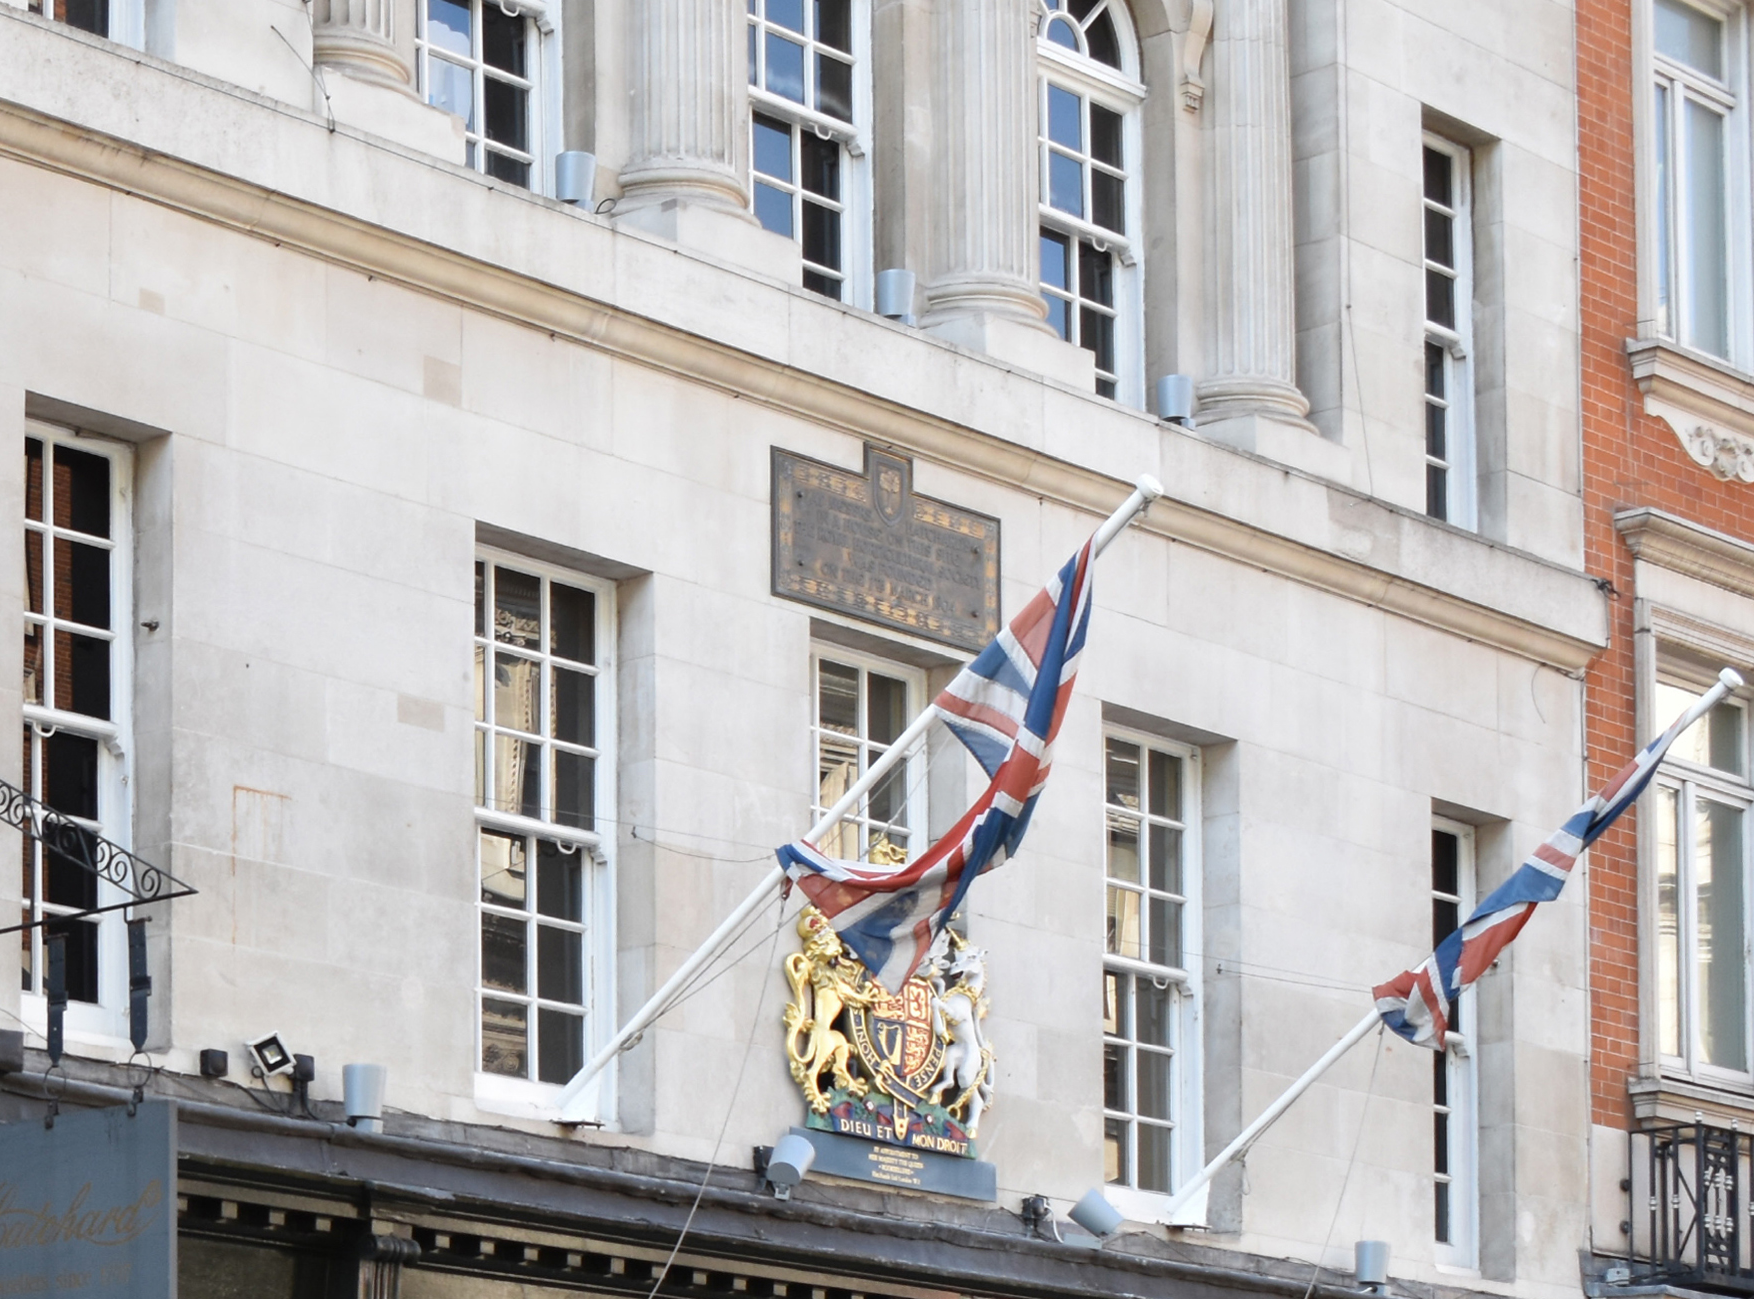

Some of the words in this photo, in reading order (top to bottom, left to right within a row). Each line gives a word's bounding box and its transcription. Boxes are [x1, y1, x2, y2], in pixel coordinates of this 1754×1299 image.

[856, 1025, 877, 1066] HONI
[914, 1047, 941, 1087] PENSE
[840, 1118, 871, 1137] DIEU
[876, 1125, 893, 1139] ET
[912, 1133, 934, 1149] MON
[937, 1136, 968, 1155] DROIT
